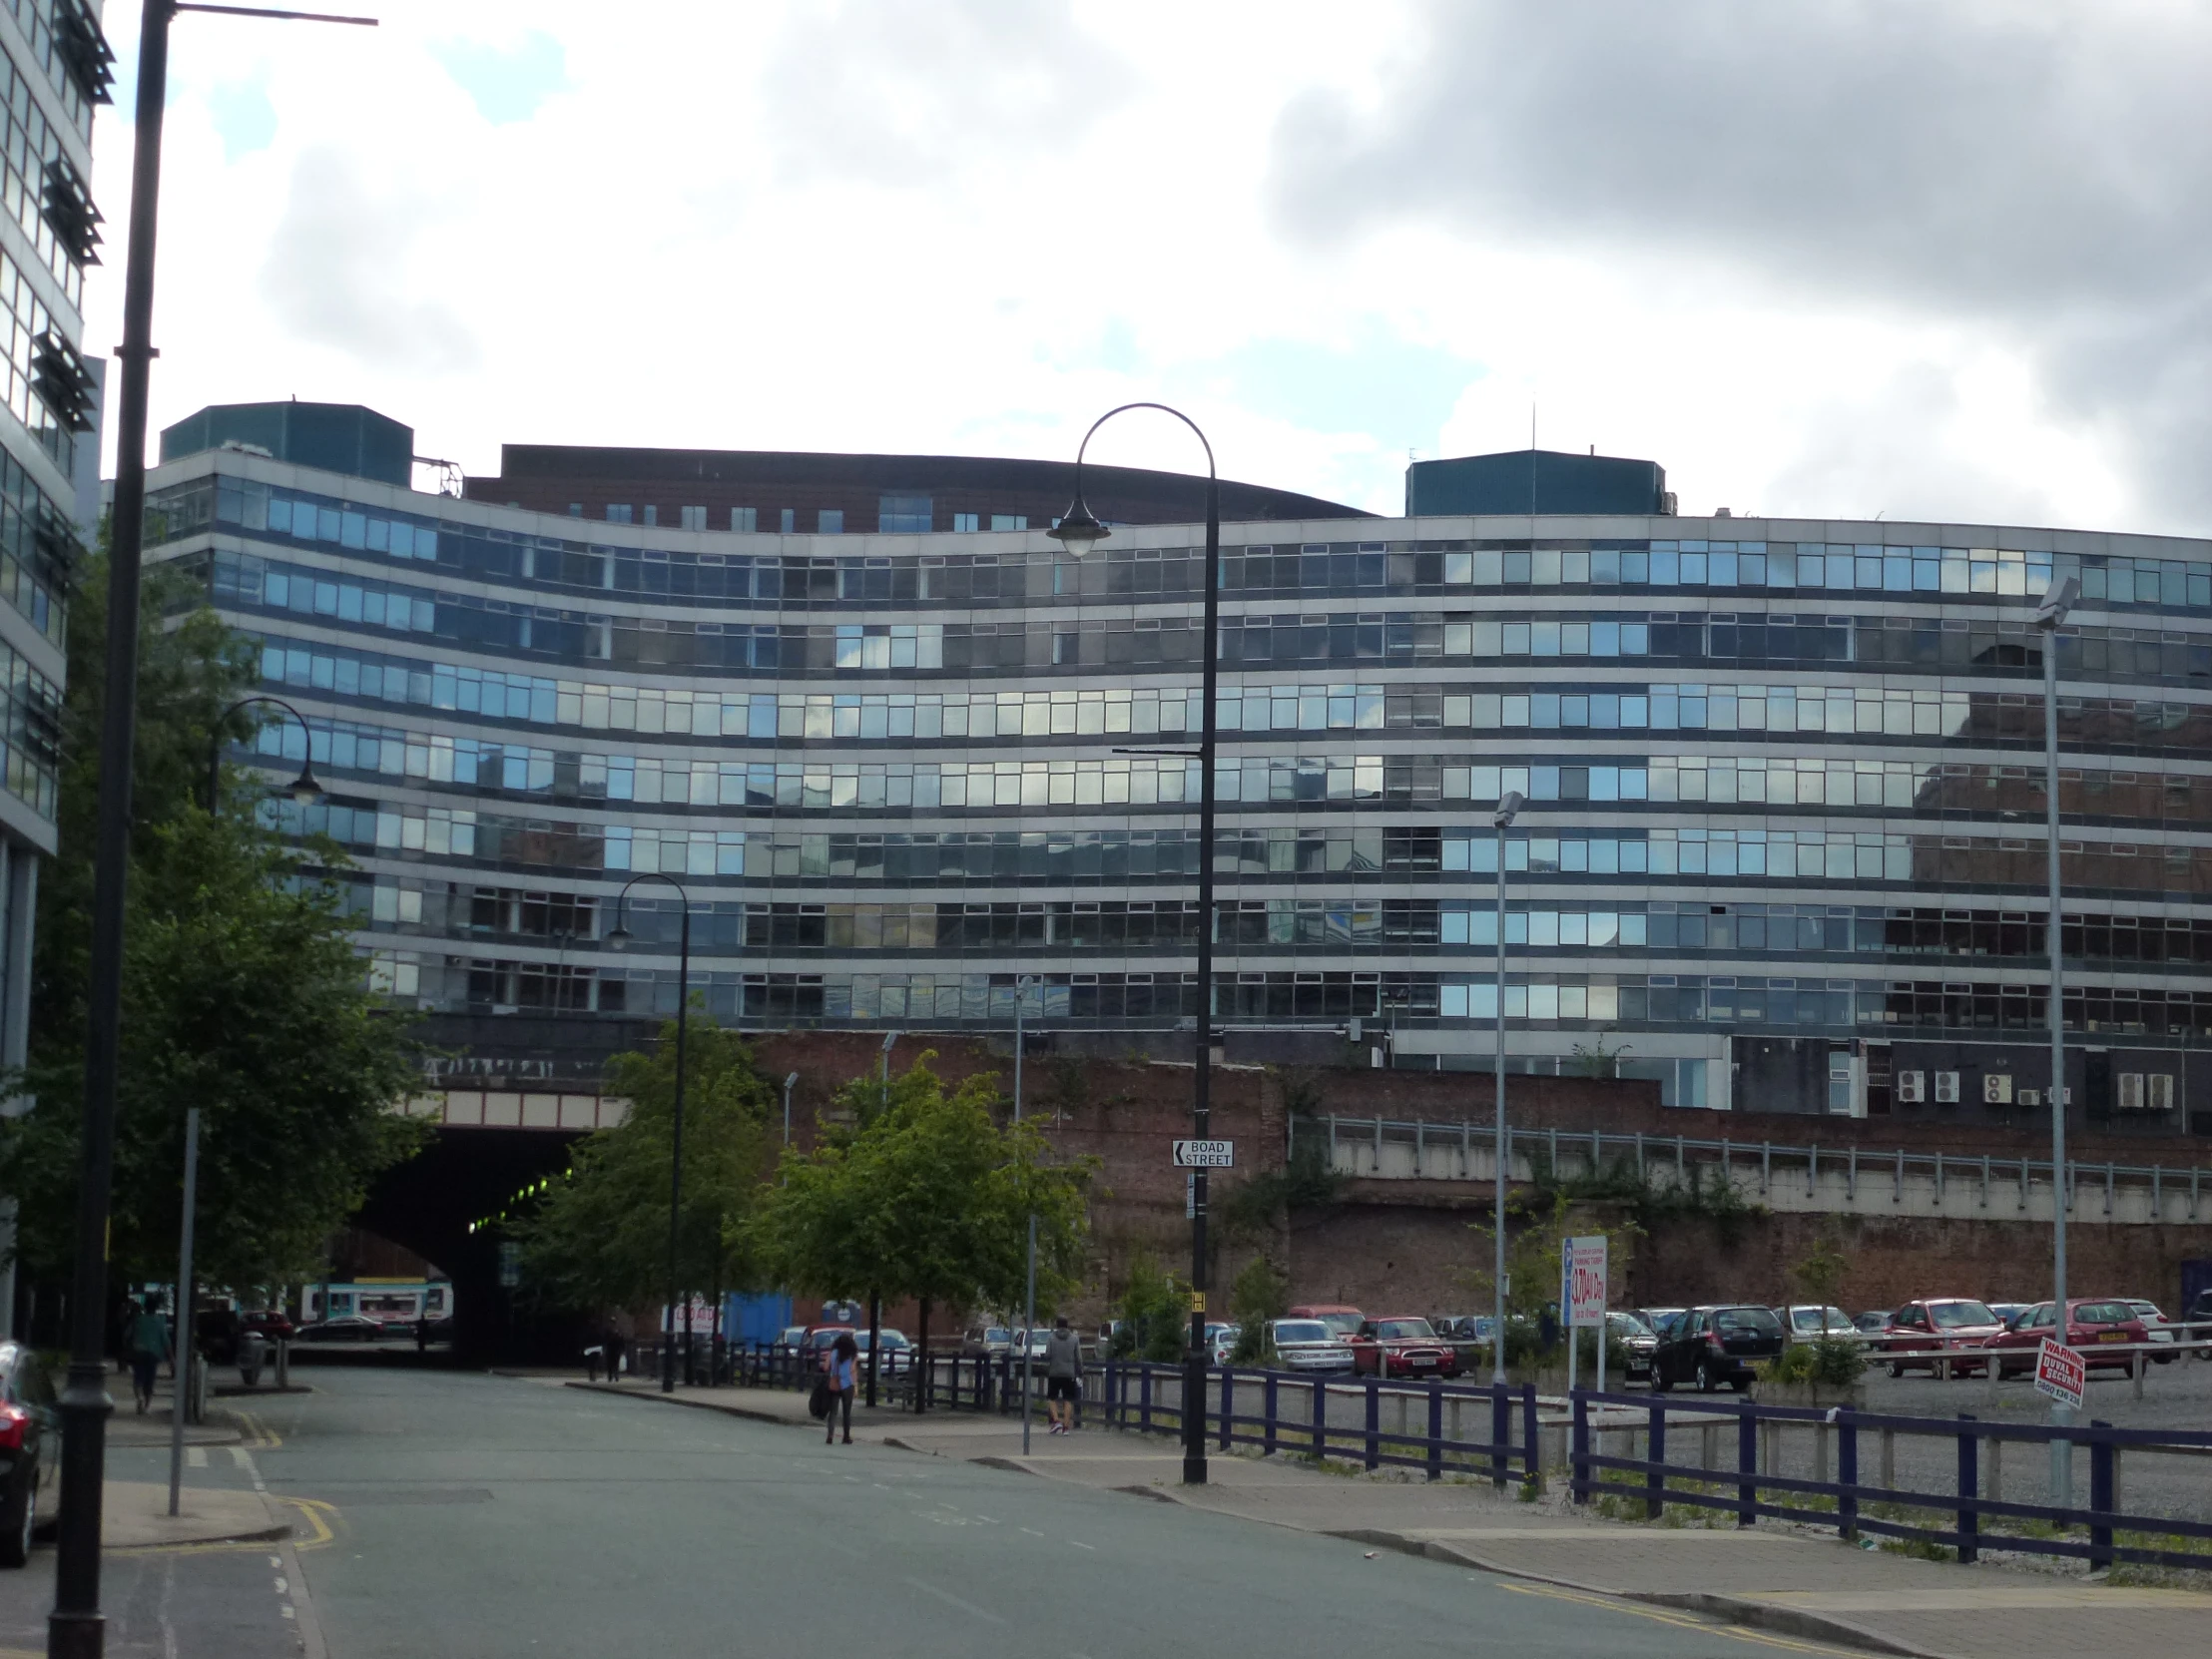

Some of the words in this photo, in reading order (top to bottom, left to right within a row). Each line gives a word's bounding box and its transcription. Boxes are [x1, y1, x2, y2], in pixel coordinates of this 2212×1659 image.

[1191, 1142, 1225, 1153] BOAD
[1186, 1154, 1231, 1165] STREET
[2046, 1341, 2083, 1369] WARNING
[2043, 1356, 2070, 1374] DUVAL
[2046, 1368, 2081, 1391] SECURITY
[2037, 1382, 2054, 1393] 0800
